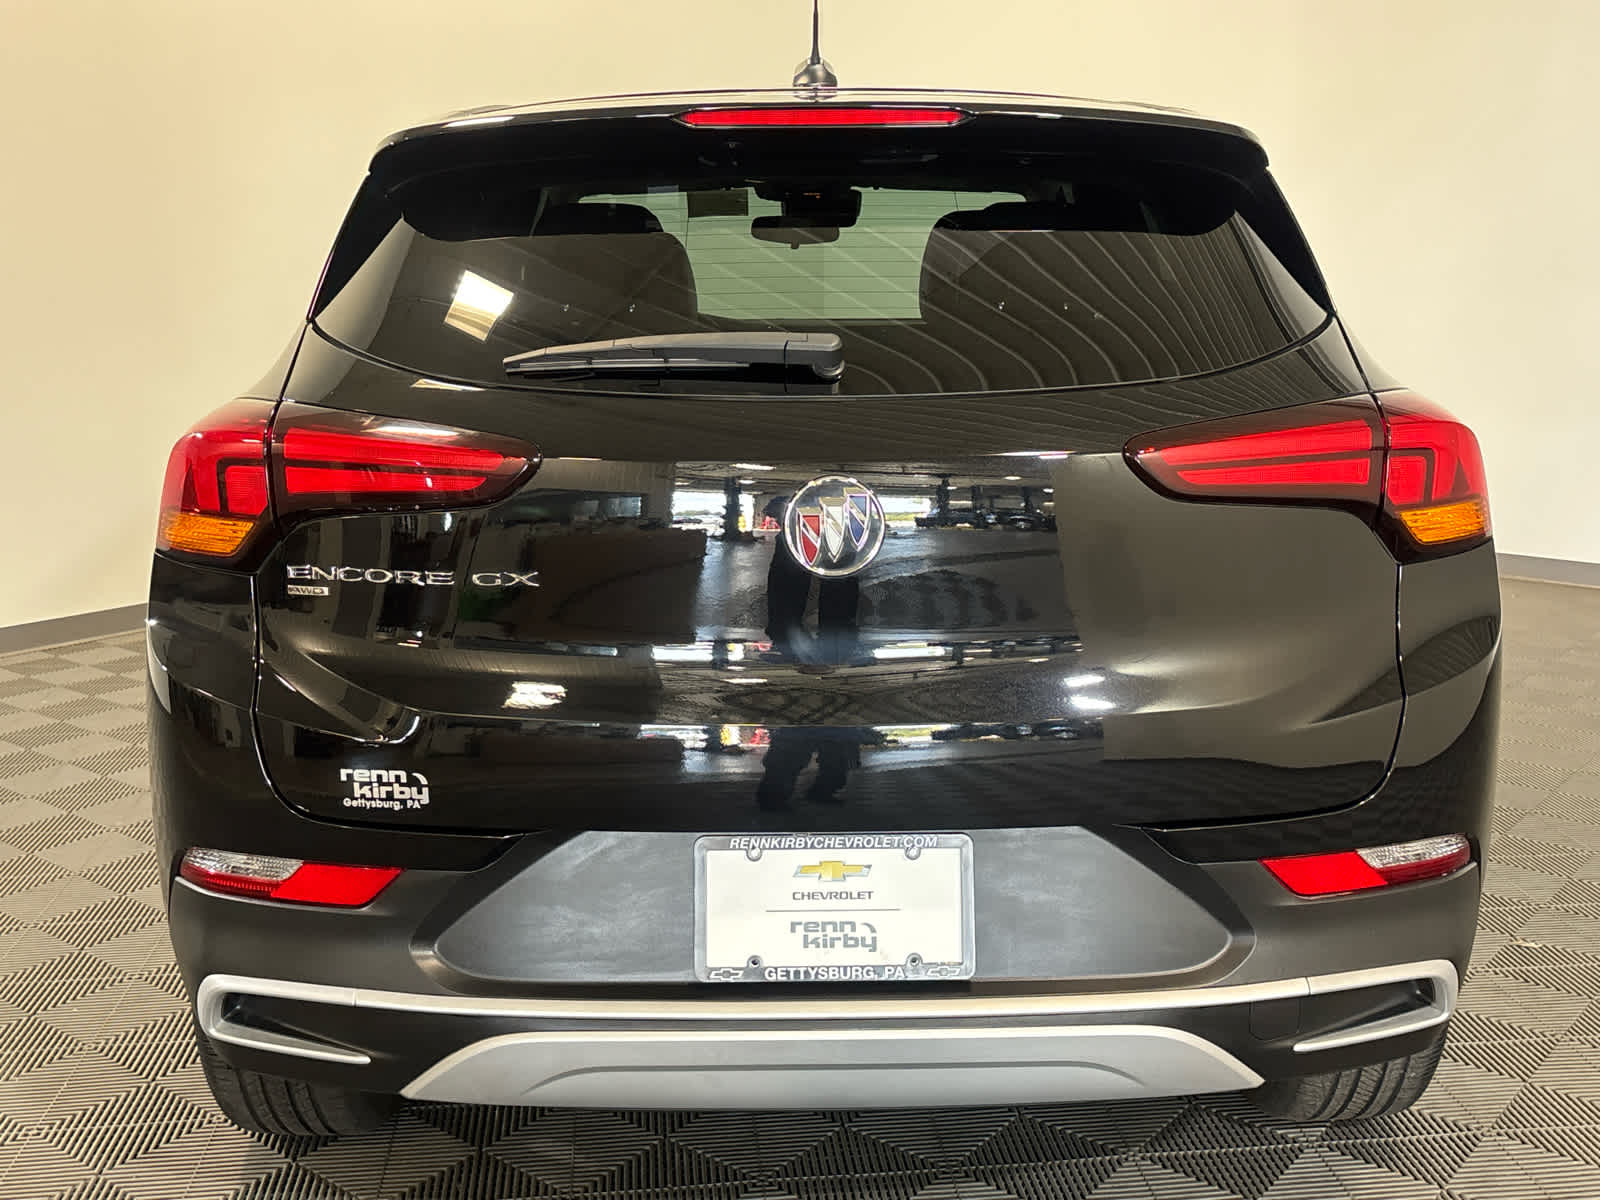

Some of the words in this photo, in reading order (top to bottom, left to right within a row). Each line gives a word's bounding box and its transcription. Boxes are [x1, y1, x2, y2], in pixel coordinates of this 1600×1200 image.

[286, 563, 456, 587] ENCORE
[471, 570, 541, 588] GX
[340, 768, 407, 784] renn
[353, 782, 430, 805] kirby
[406, 799, 421, 809] PA
[729, 835, 938, 850] RENNKIRBYCHEVROLET.COM
[792, 890, 875, 901] CHEVROLET
[790, 920, 857, 934] renn
[802, 934, 878, 953] kirby
[884, 966, 907, 979] PA
